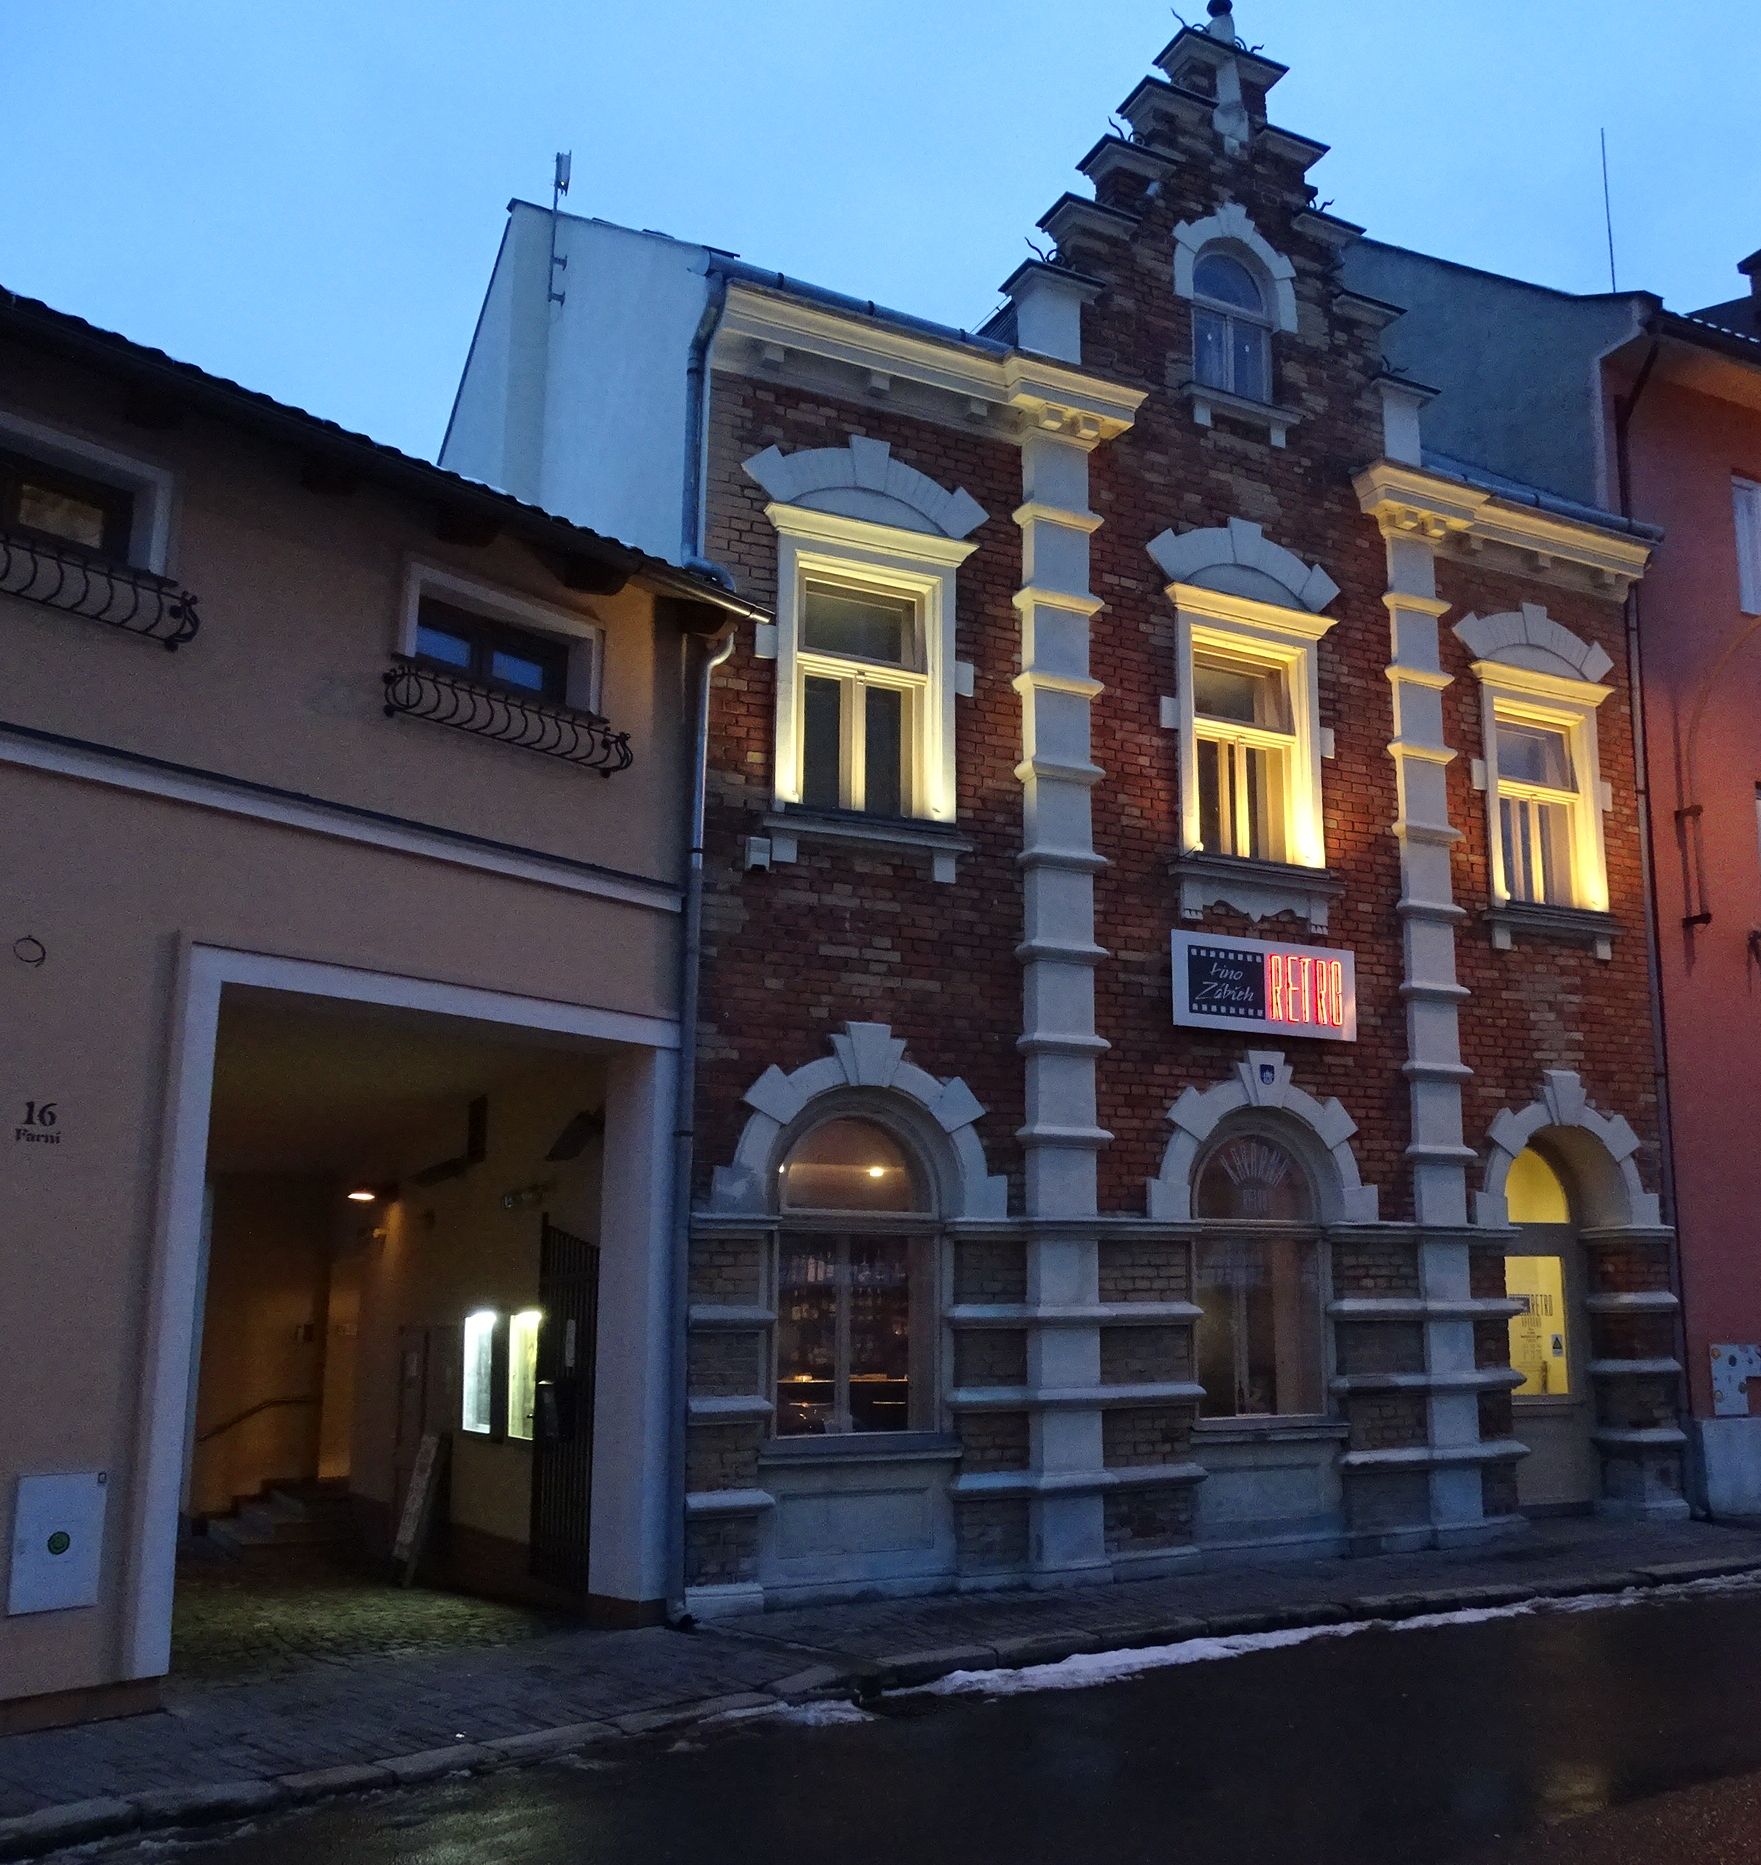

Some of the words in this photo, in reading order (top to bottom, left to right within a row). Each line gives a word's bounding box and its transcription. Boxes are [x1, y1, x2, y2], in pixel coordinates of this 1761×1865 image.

[1269, 954, 1343, 1027] RETRO
[22, 1101, 58, 1127] 16
[15, 1128, 61, 1144] Farní
